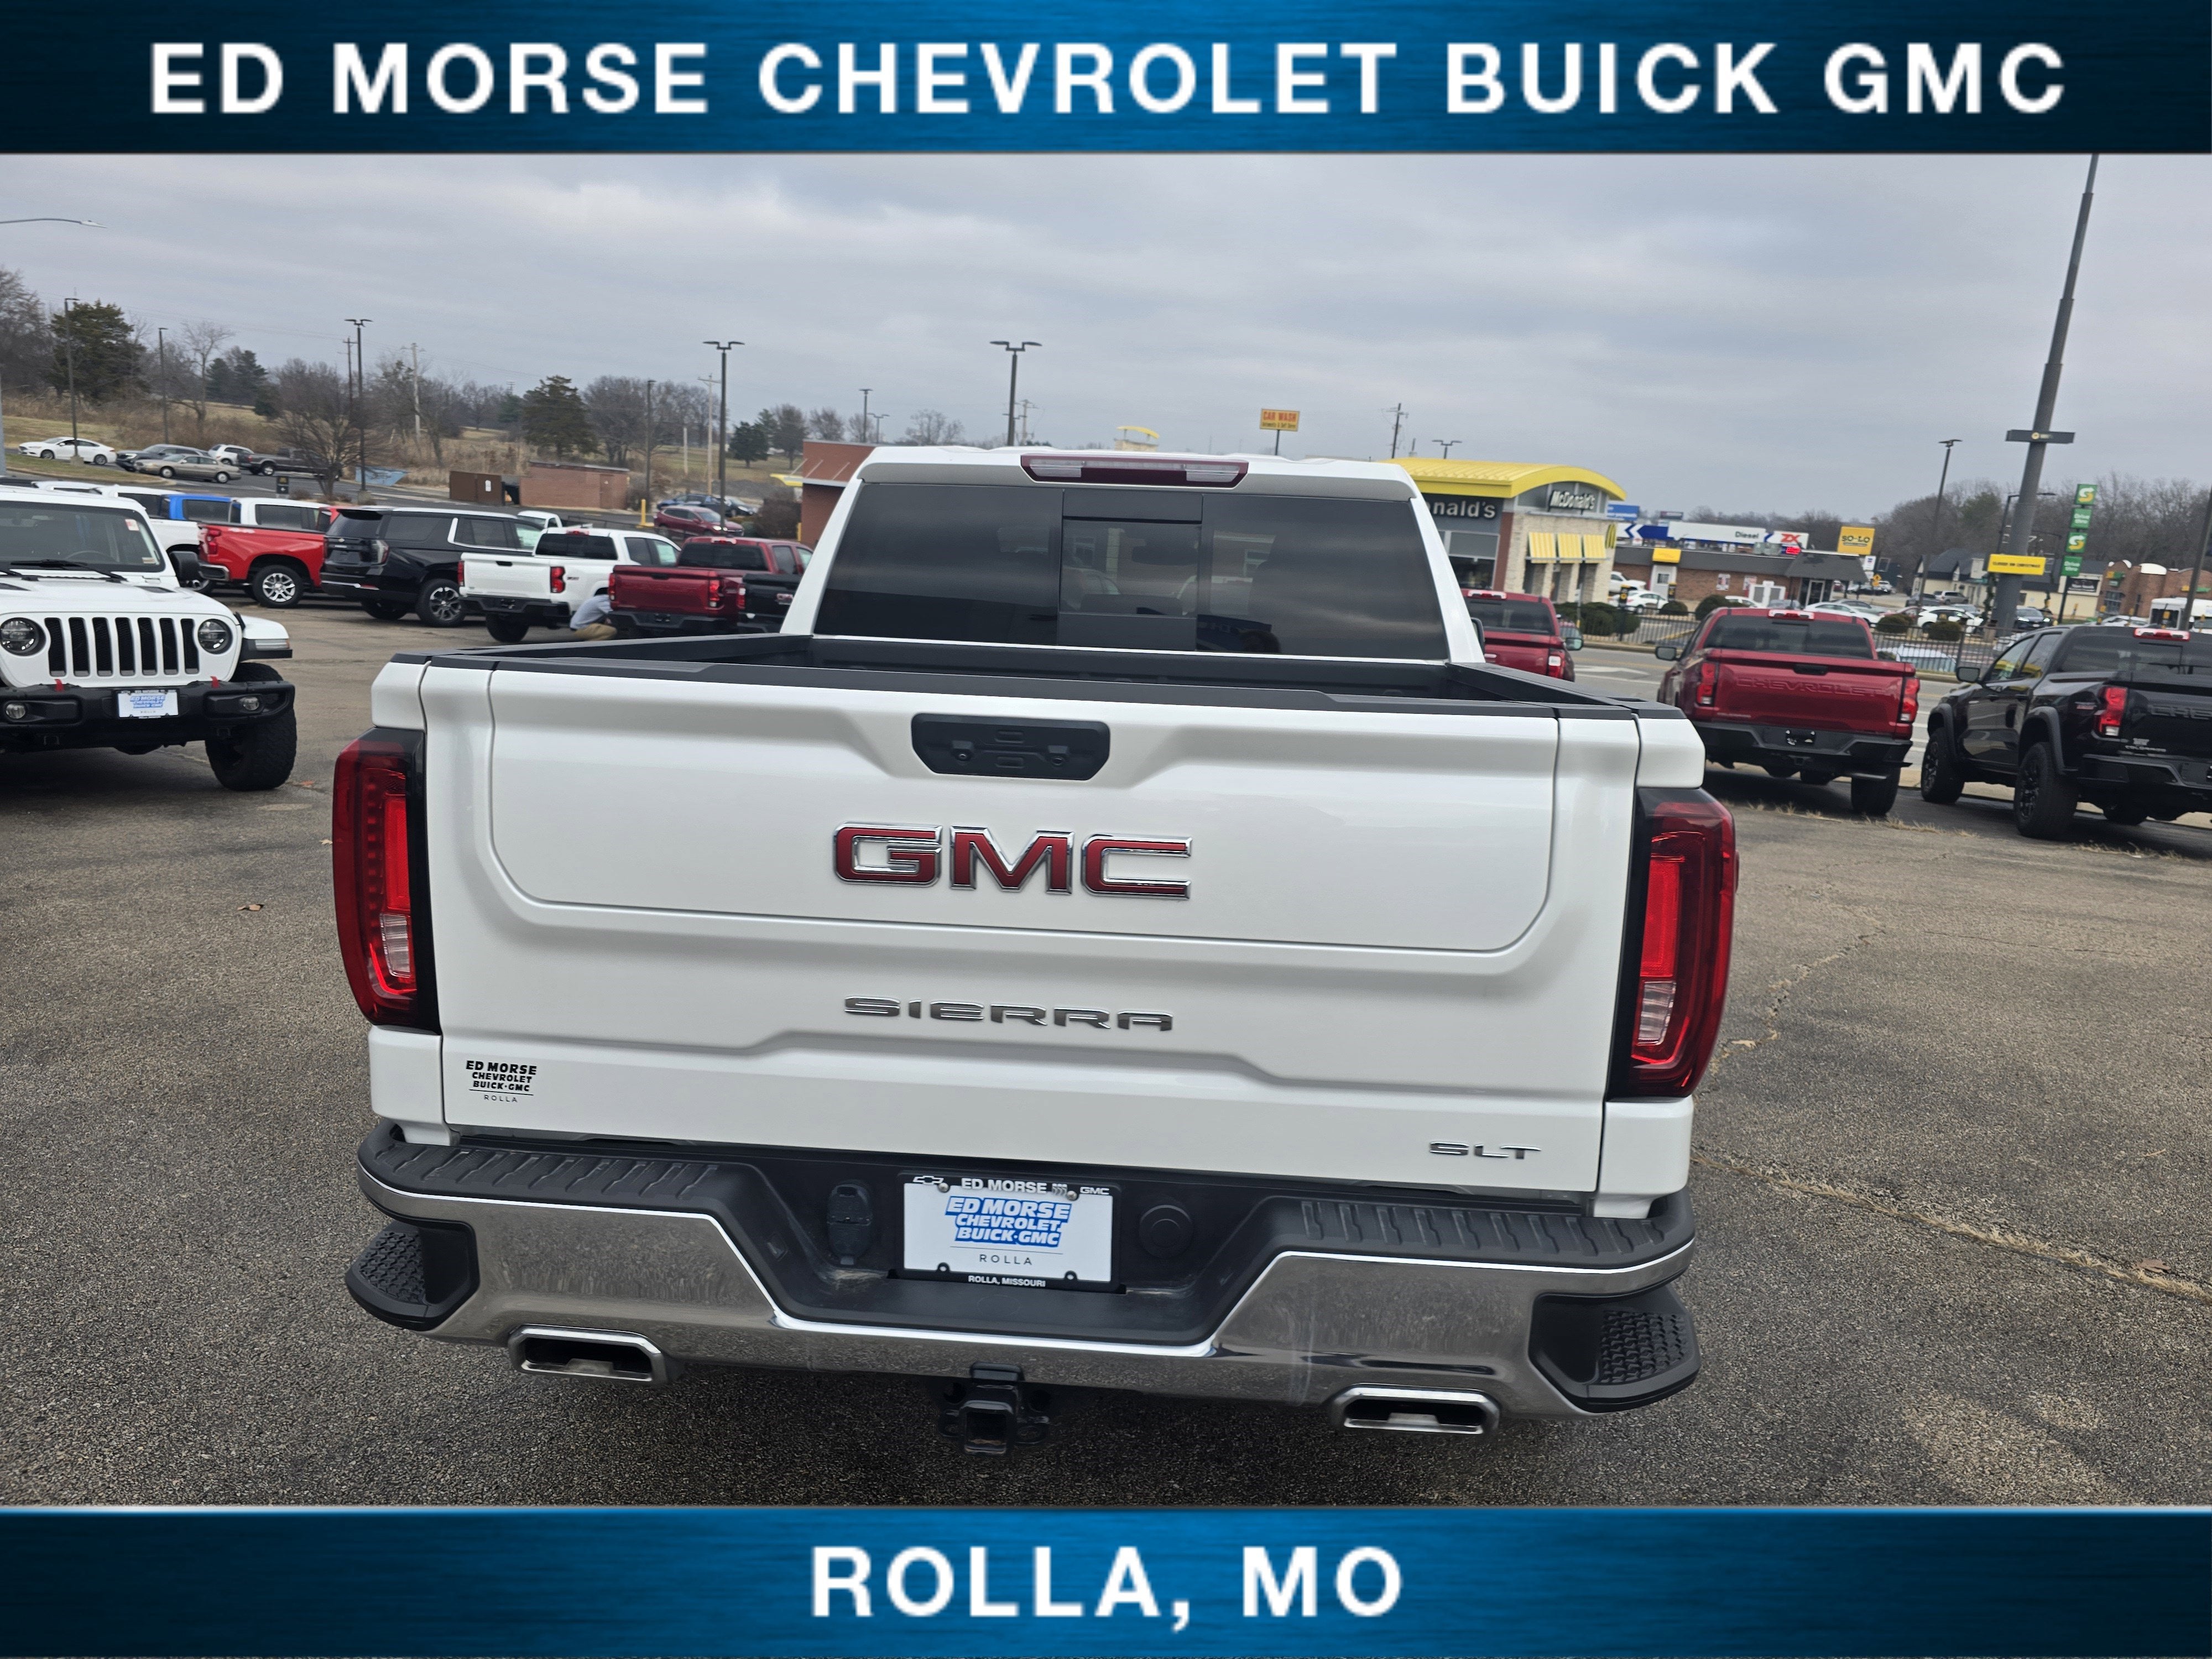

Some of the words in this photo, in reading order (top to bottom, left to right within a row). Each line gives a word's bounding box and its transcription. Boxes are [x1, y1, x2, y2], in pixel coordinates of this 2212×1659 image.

[1263, 411, 1276, 421] CAR
[1279, 412, 1297, 422] WASH
[1550, 490, 1596, 510] McDonald's
[1430, 500, 1496, 518] nald's
[1735, 531, 1759, 539] Diesel
[1841, 535, 1870, 544] SO-LO
[1736, 677, 1885, 697] CHEVROLET
[833, 821, 1193, 900] GMC
[844, 995, 1173, 1032] SIERRA
[466, 1060, 484, 1071] ED
[487, 1062, 537, 1075] MORSE
[472, 1072, 532, 1083] CHEVROLET
[484, 1094, 518, 1103] ROLLA
[1430, 1141, 1542, 1160] SLT
[961, 1178, 984, 1190] ED
[988, 1179, 1047, 1194] MORSE
[1080, 1187, 1110, 1195] GMC
[947, 1197, 981, 1213] ED
[981, 1199, 1071, 1220] MORSE
[979, 1254, 1032, 1265] ROLLA
[968, 1275, 1000, 1286] ROLLA,
[1001, 1277, 1046, 1288] MISSOURI
